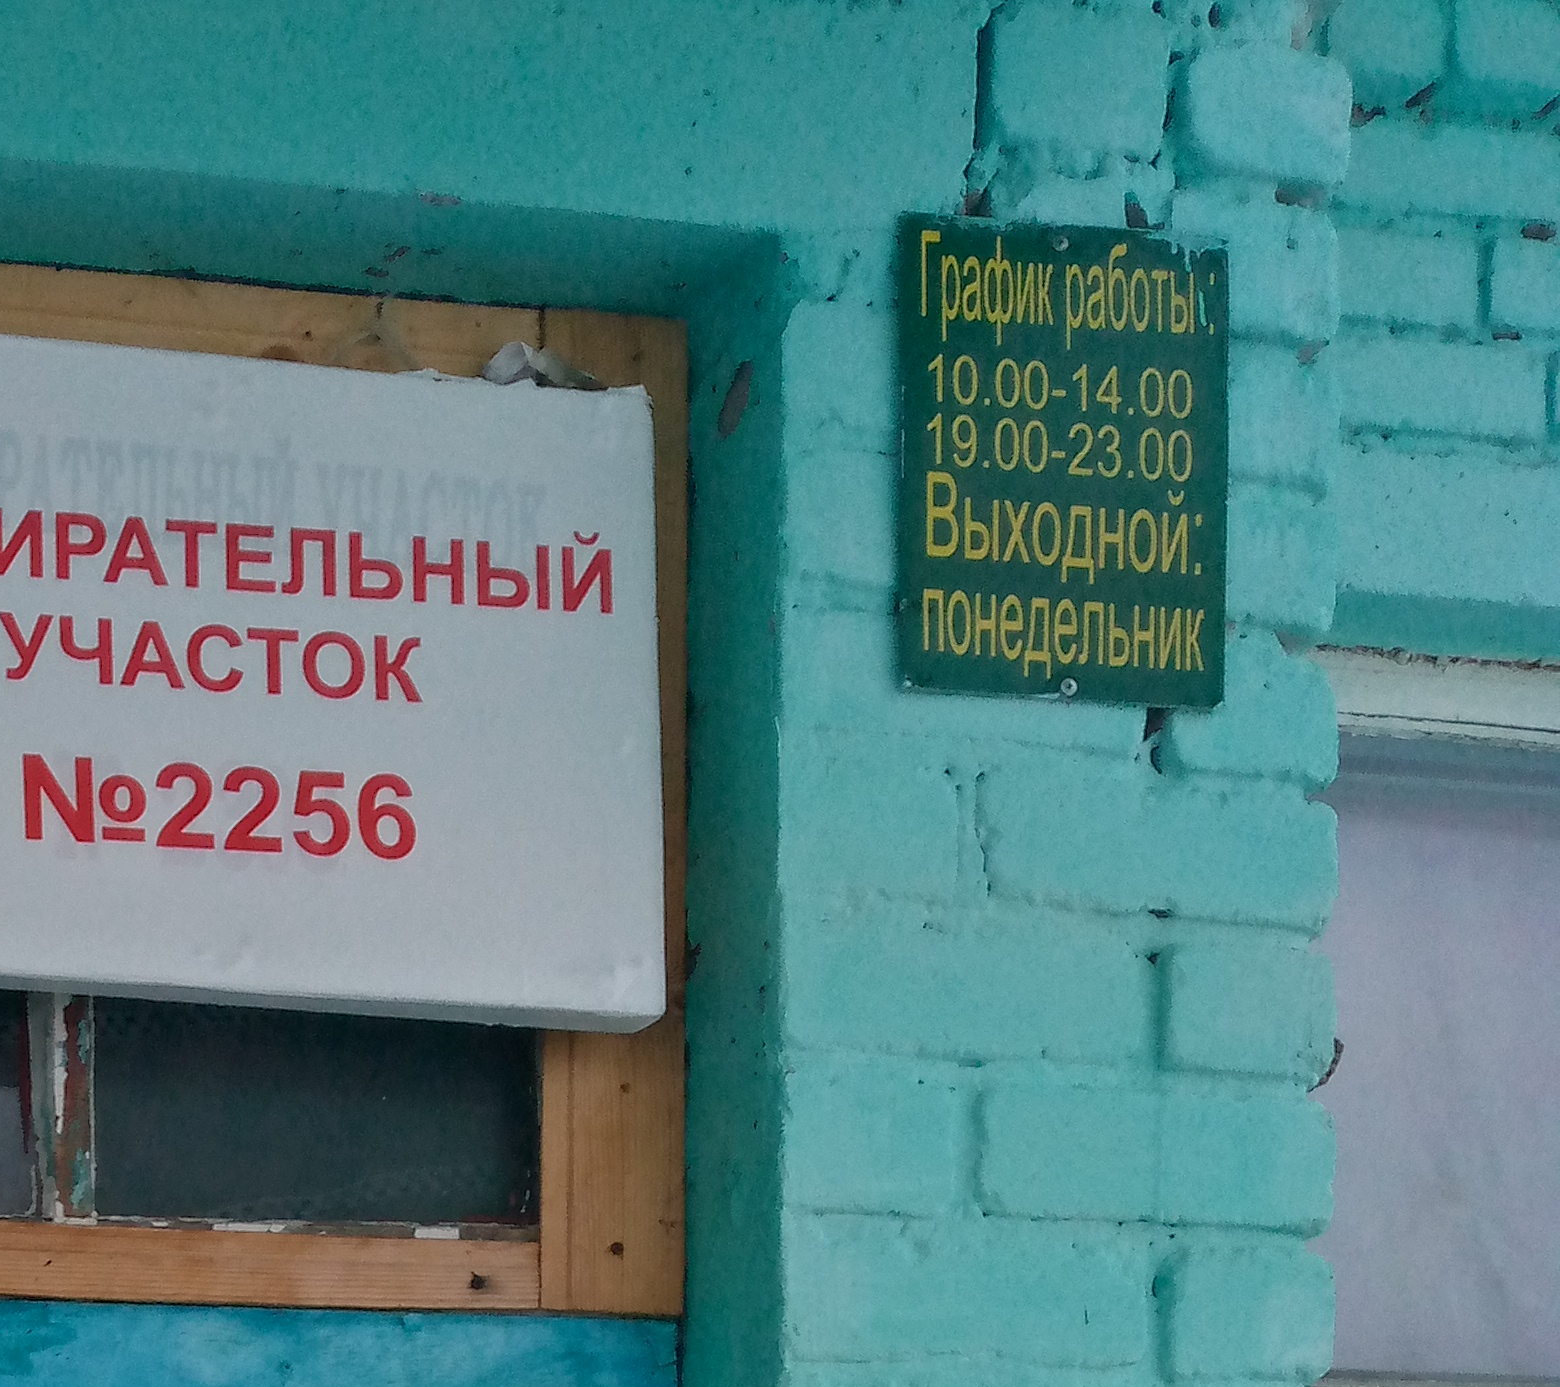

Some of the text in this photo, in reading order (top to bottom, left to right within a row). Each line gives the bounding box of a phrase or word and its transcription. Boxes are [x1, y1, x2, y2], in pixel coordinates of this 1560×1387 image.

[920, 230, 1054, 345] График
[927, 354, 1193, 420] 10.00-14.00
[927, 413, 1193, 482] 19.00-23.00
[926, 471, 1203, 585] Выходной:
[922, 588, 1205, 679] понедельник
[21, 753, 418, 861] №2256
